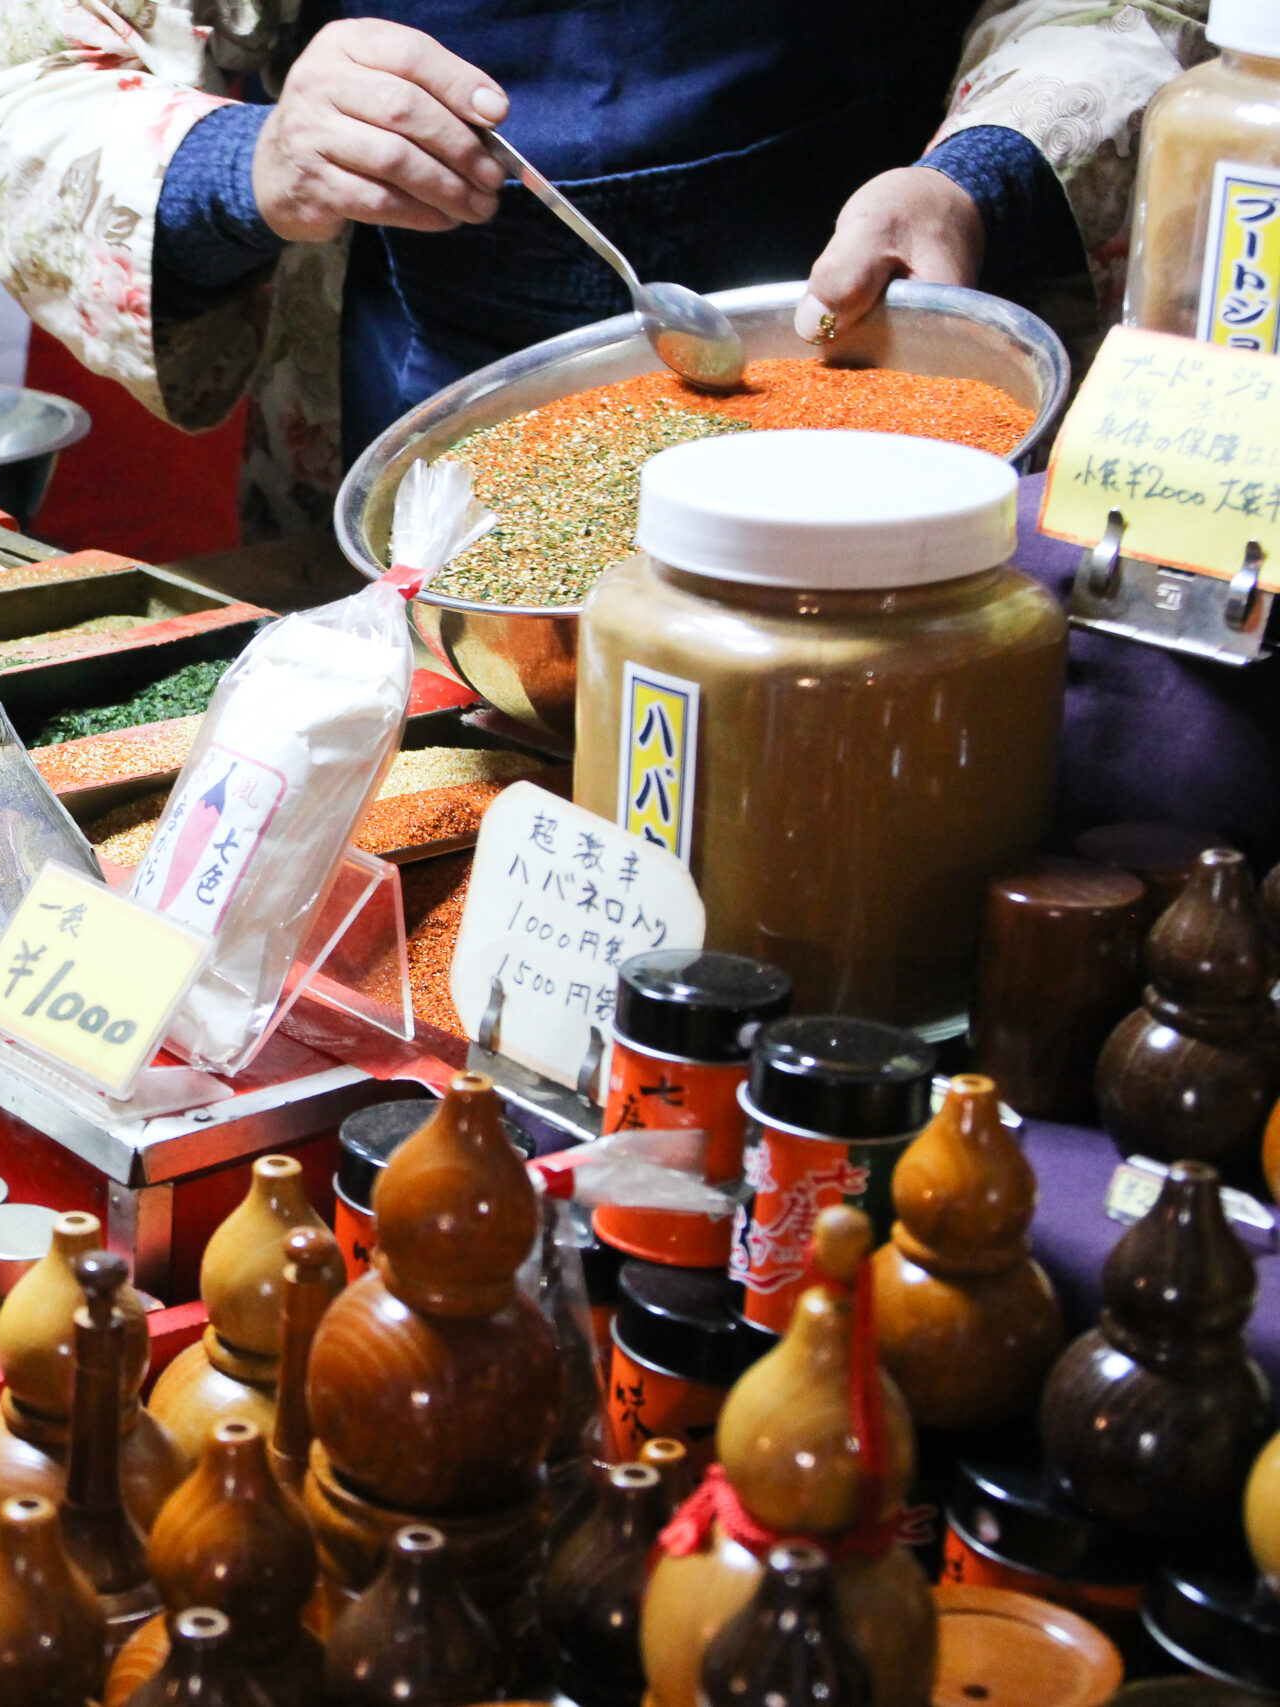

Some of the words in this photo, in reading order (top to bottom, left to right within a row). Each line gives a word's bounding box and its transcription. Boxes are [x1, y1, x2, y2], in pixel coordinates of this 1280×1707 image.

[38, 901, 88, 939] 一袋
[508, 853, 667, 949] ハバネロ入り
[3, 939, 139, 1047] ¥1000
